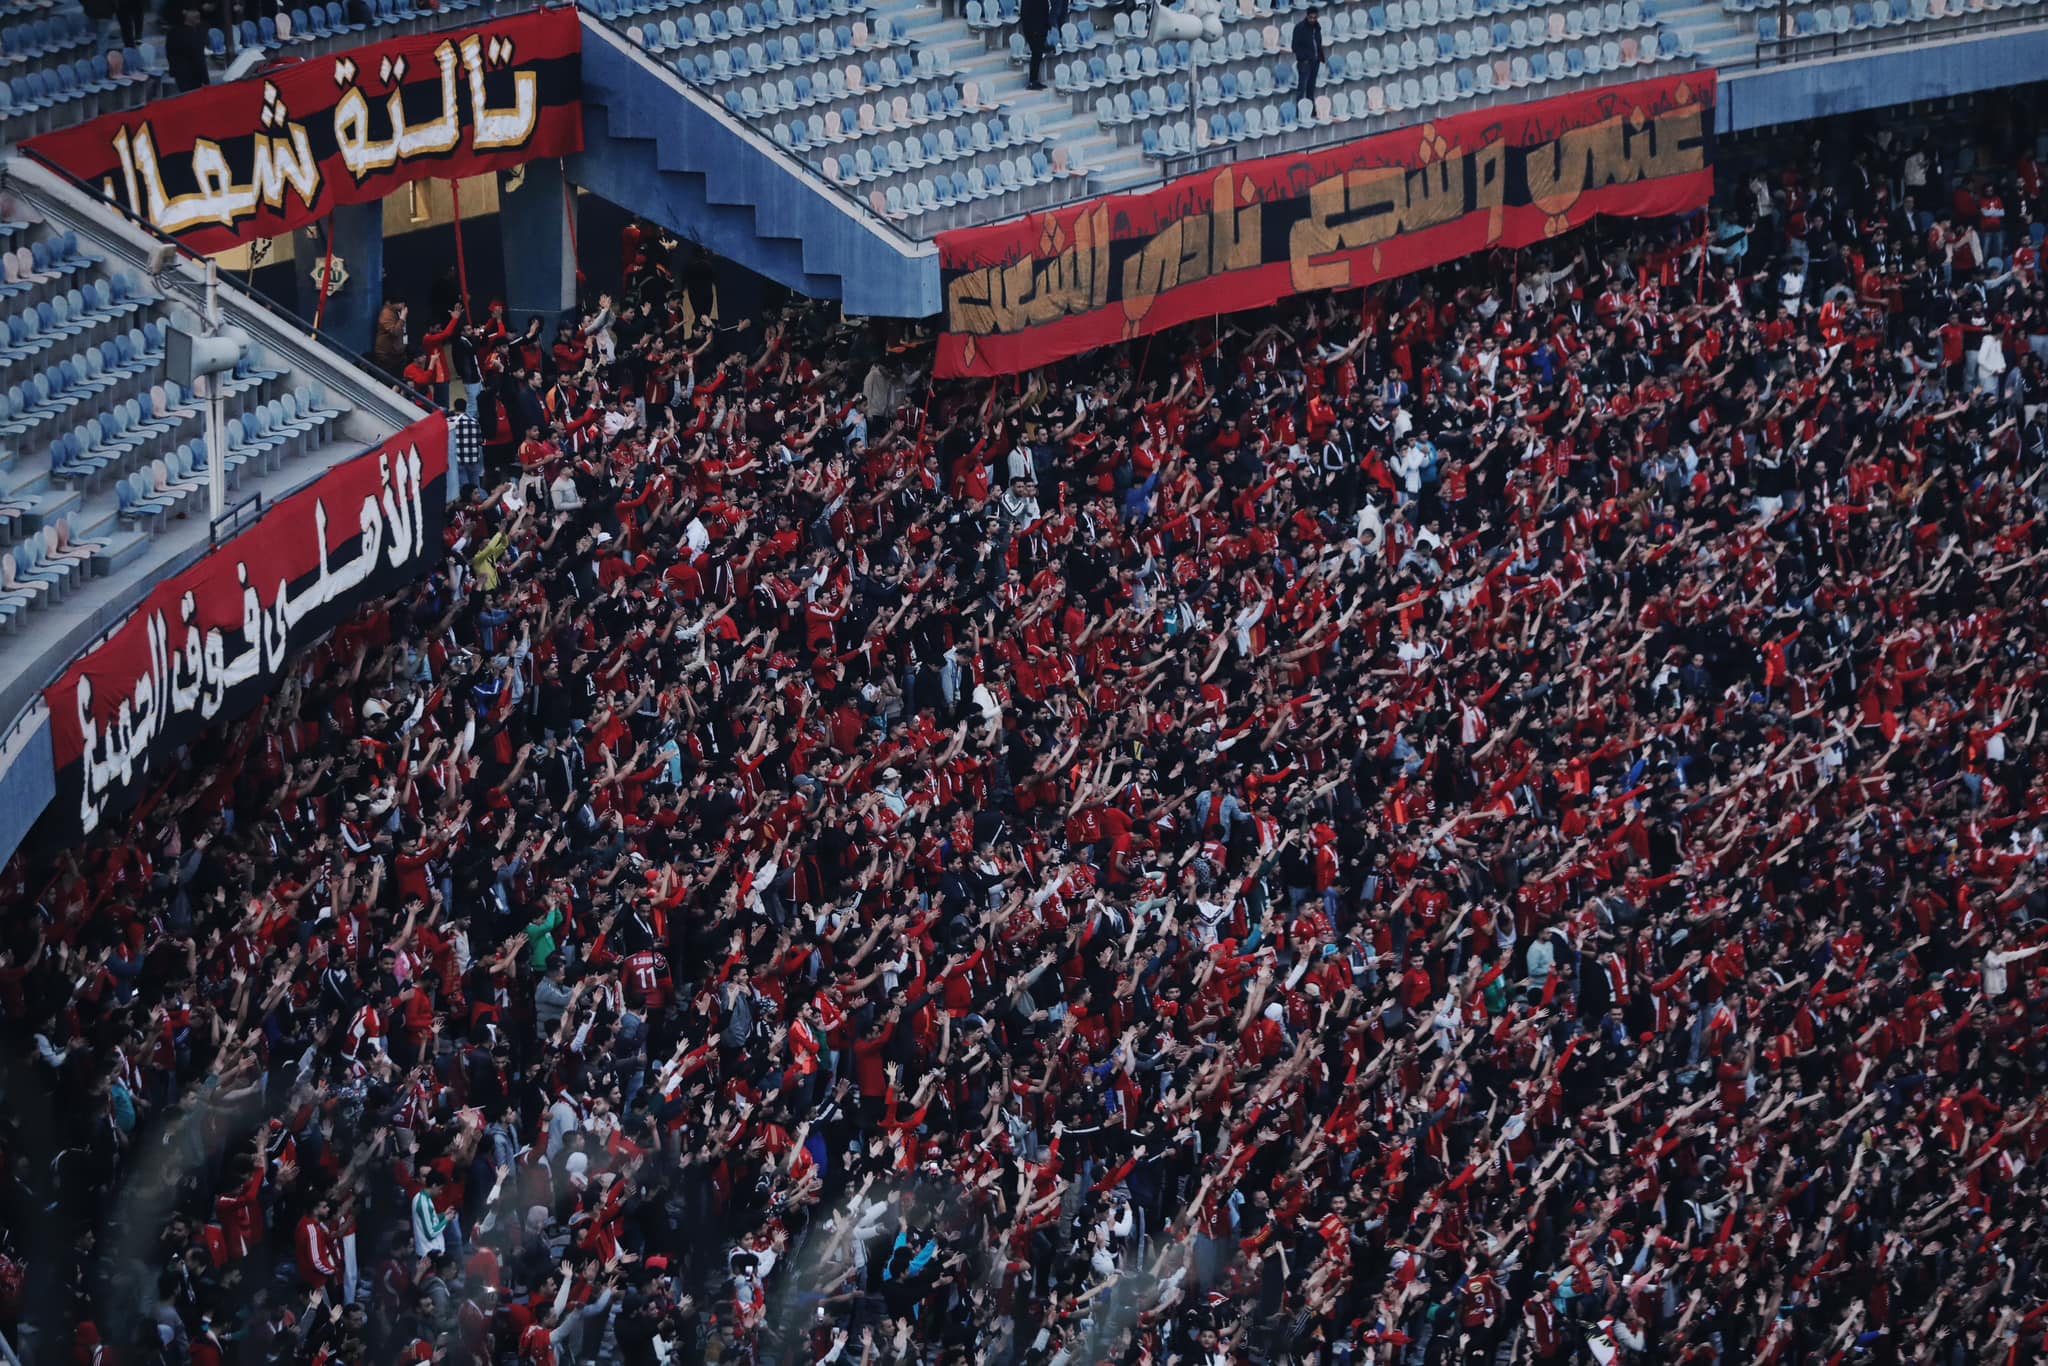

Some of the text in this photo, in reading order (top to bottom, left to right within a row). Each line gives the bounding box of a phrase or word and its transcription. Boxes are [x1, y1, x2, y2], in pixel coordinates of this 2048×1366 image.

[333, 34, 538, 179] تالتة
[171, 561, 262, 721] فوق
[76, 607, 168, 836] الجميع
[635, 967, 658, 989] 11
